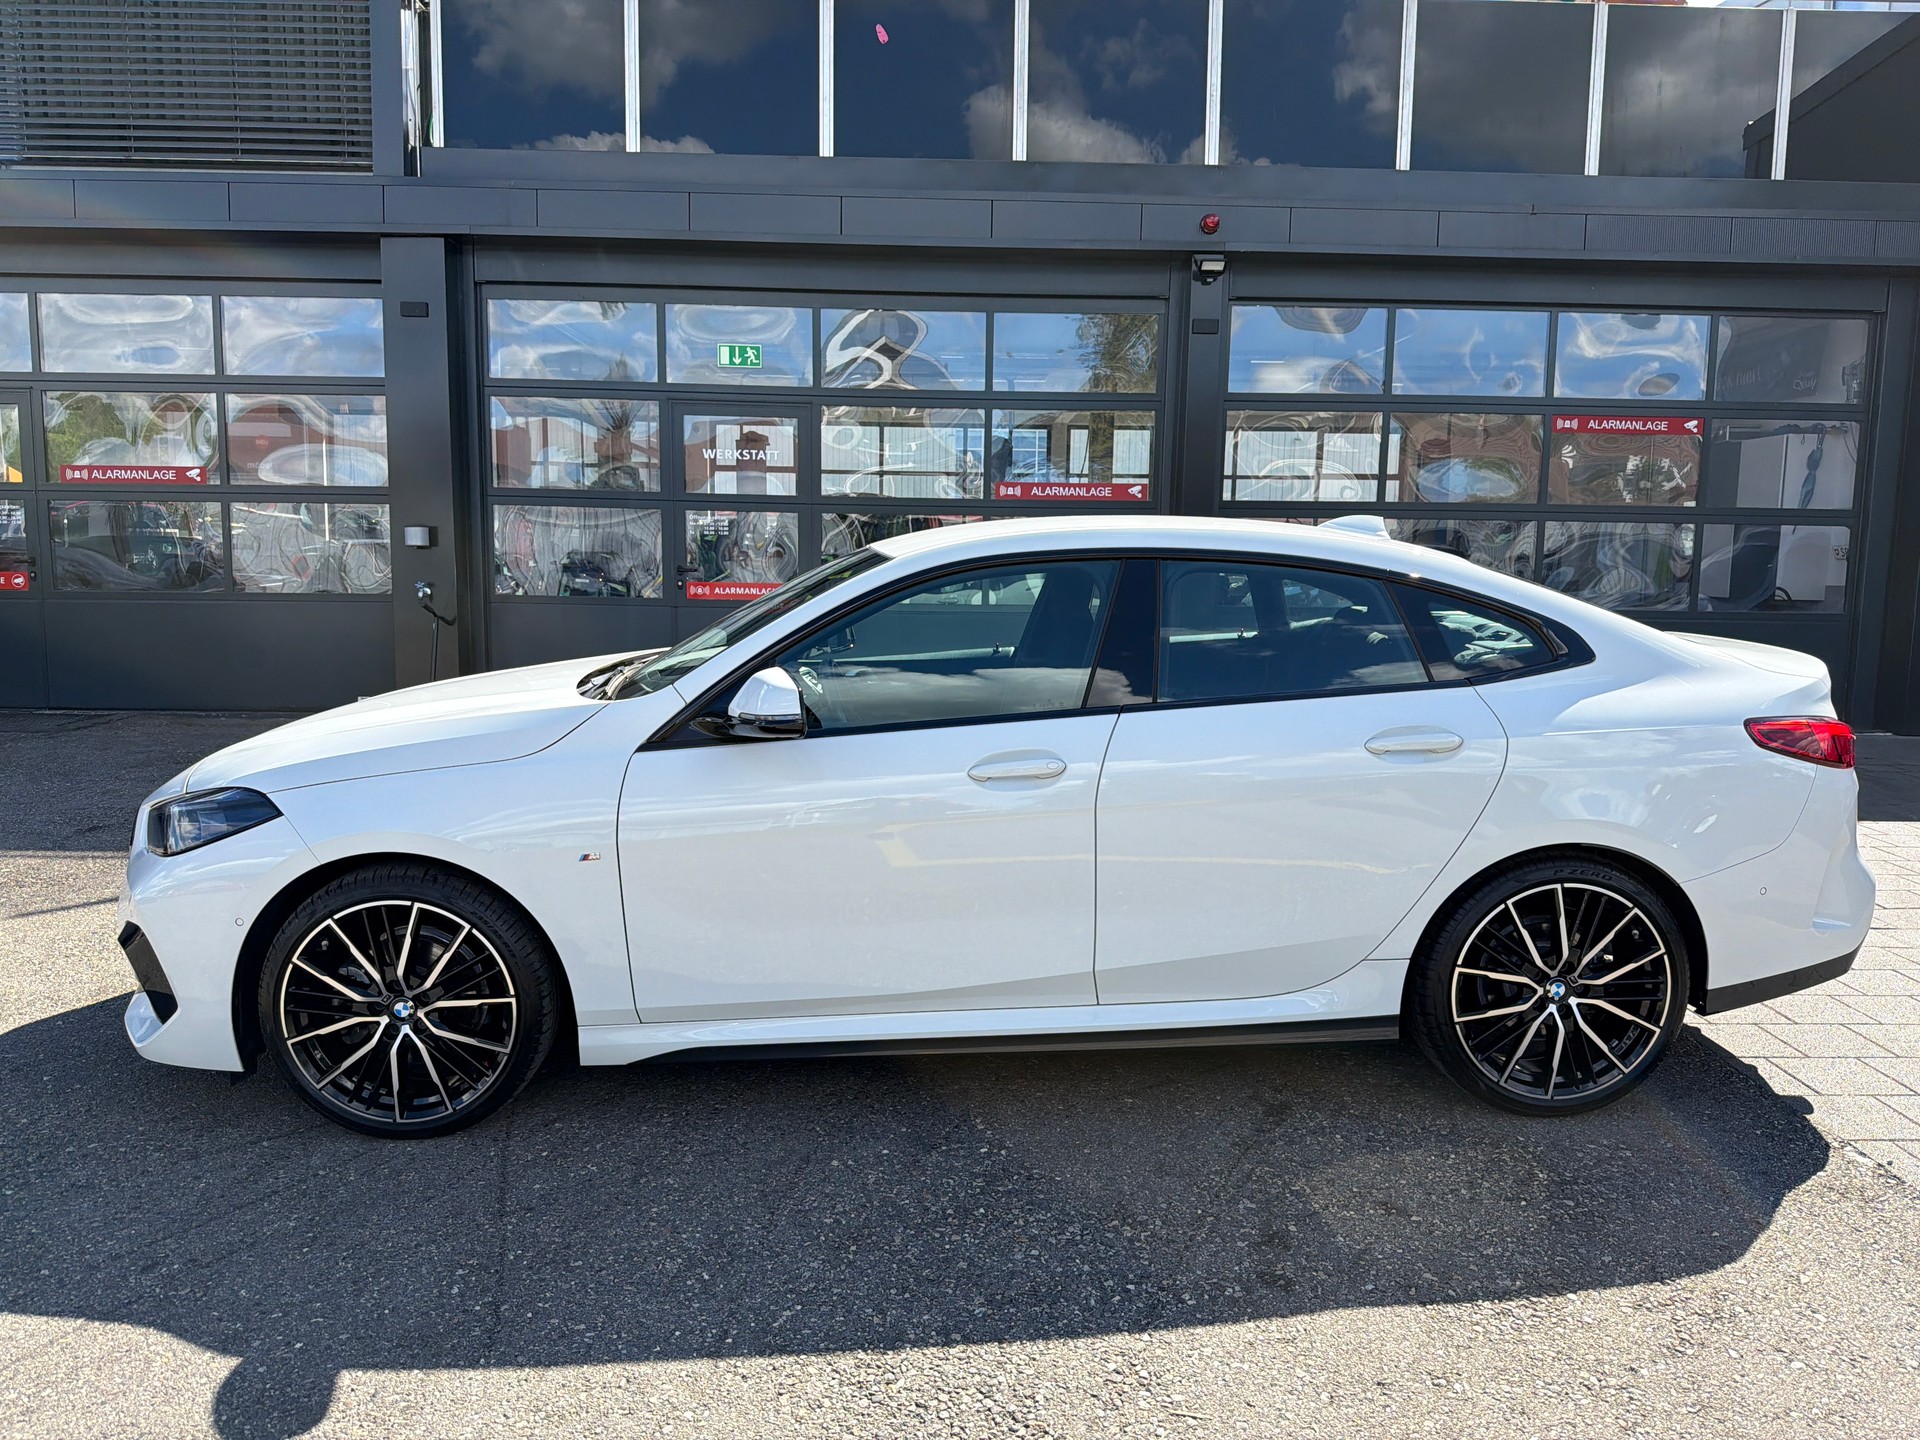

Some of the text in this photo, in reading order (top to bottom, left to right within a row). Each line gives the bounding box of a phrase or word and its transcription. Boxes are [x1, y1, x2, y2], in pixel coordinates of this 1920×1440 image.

[1587, 419, 1669, 431] ALARMANLAGE
[702, 447, 780, 461] WERKSTATT
[91, 468, 177, 481] ALARMANLAGE
[1031, 486, 1112, 498] ALARMANLAGE
[1567, 868, 1614, 881] ZERO
